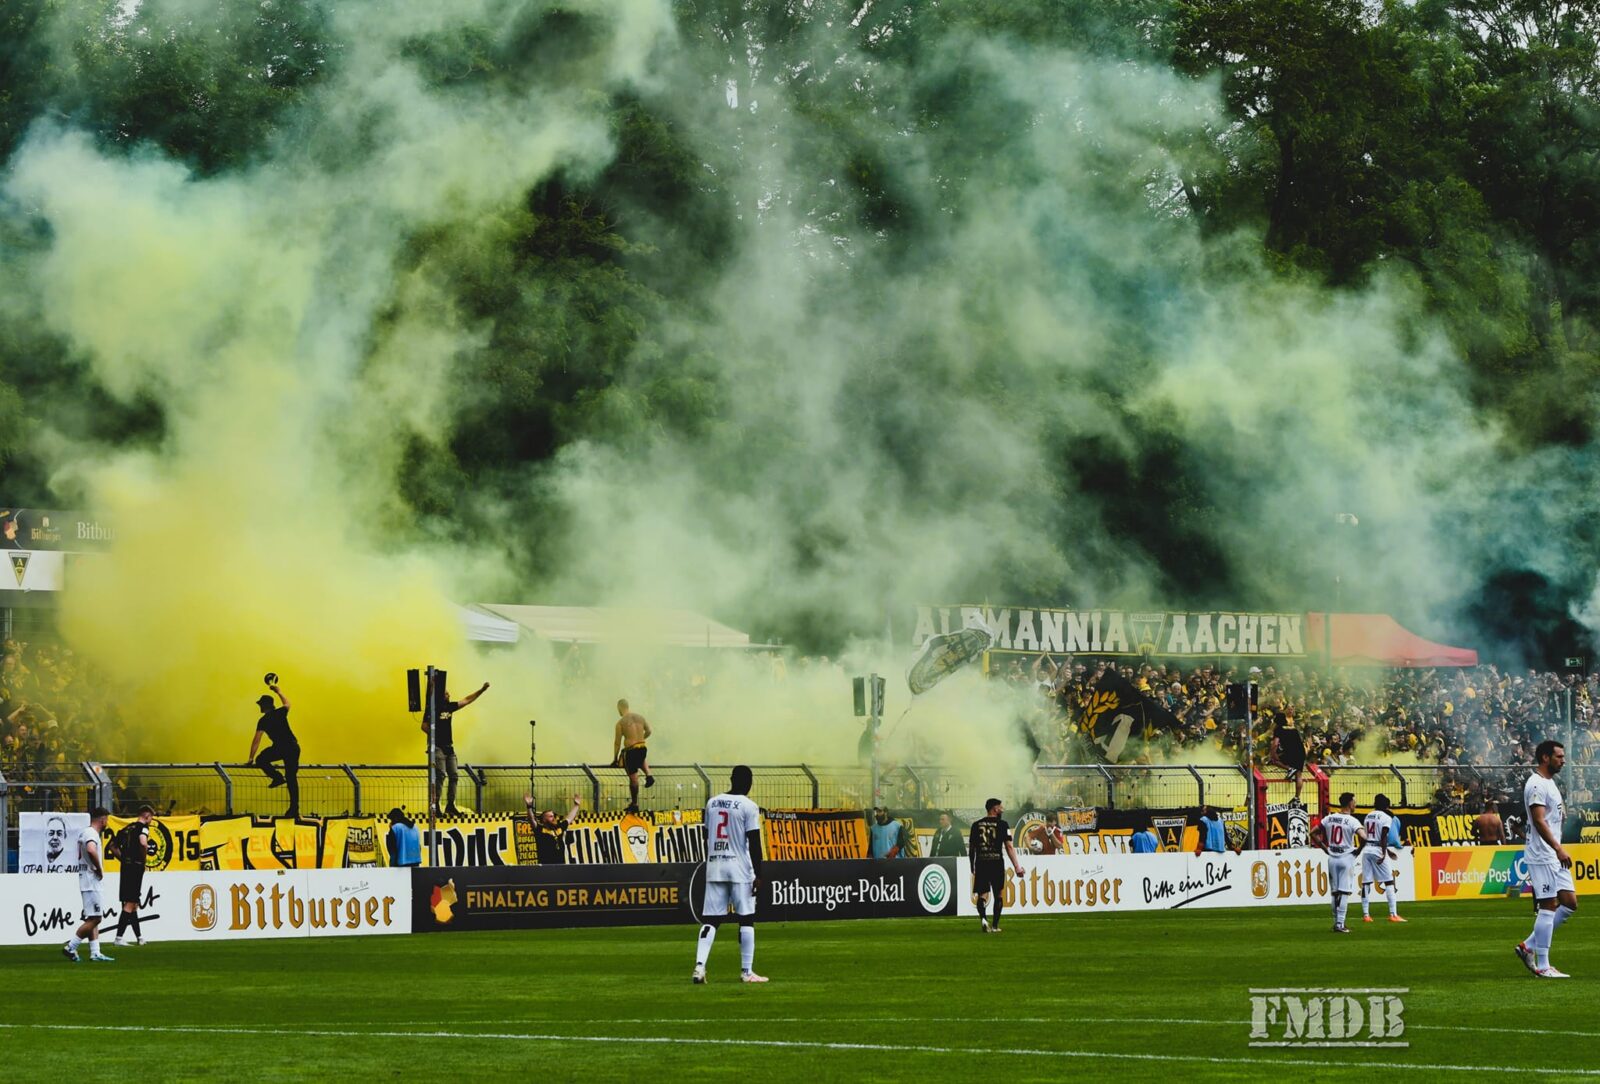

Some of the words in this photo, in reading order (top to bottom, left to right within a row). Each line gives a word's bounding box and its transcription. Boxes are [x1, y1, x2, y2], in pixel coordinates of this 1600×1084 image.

[1168, 615, 1303, 654] AACHEN
[717, 812, 729, 839] 2
[771, 820, 857, 846] FREUNDSCHAFT
[1167, 828, 1177, 844] A
[1270, 816, 1286, 838] A
[1331, 825, 1343, 844] 10
[1367, 821, 1375, 839] 14
[175, 830, 199, 861] 15
[1142, 876, 1175, 904] Bitte
[1178, 879, 1204, 894] ein
[1205, 861, 1232, 887] Bit
[1438, 868, 1485, 884] Deutsche
[1489, 867, 1511, 882] Post
[1542, 884, 1550, 893] 24
[228, 882, 395, 930] Bitburger
[467, 889, 548, 909] FINALTAG
[556, 888, 589, 907] DER
[594, 886, 679, 906] AMATEURE
[771, 875, 905, 911] Bitburger-Pokal
[23, 903, 74, 936] Bitte
